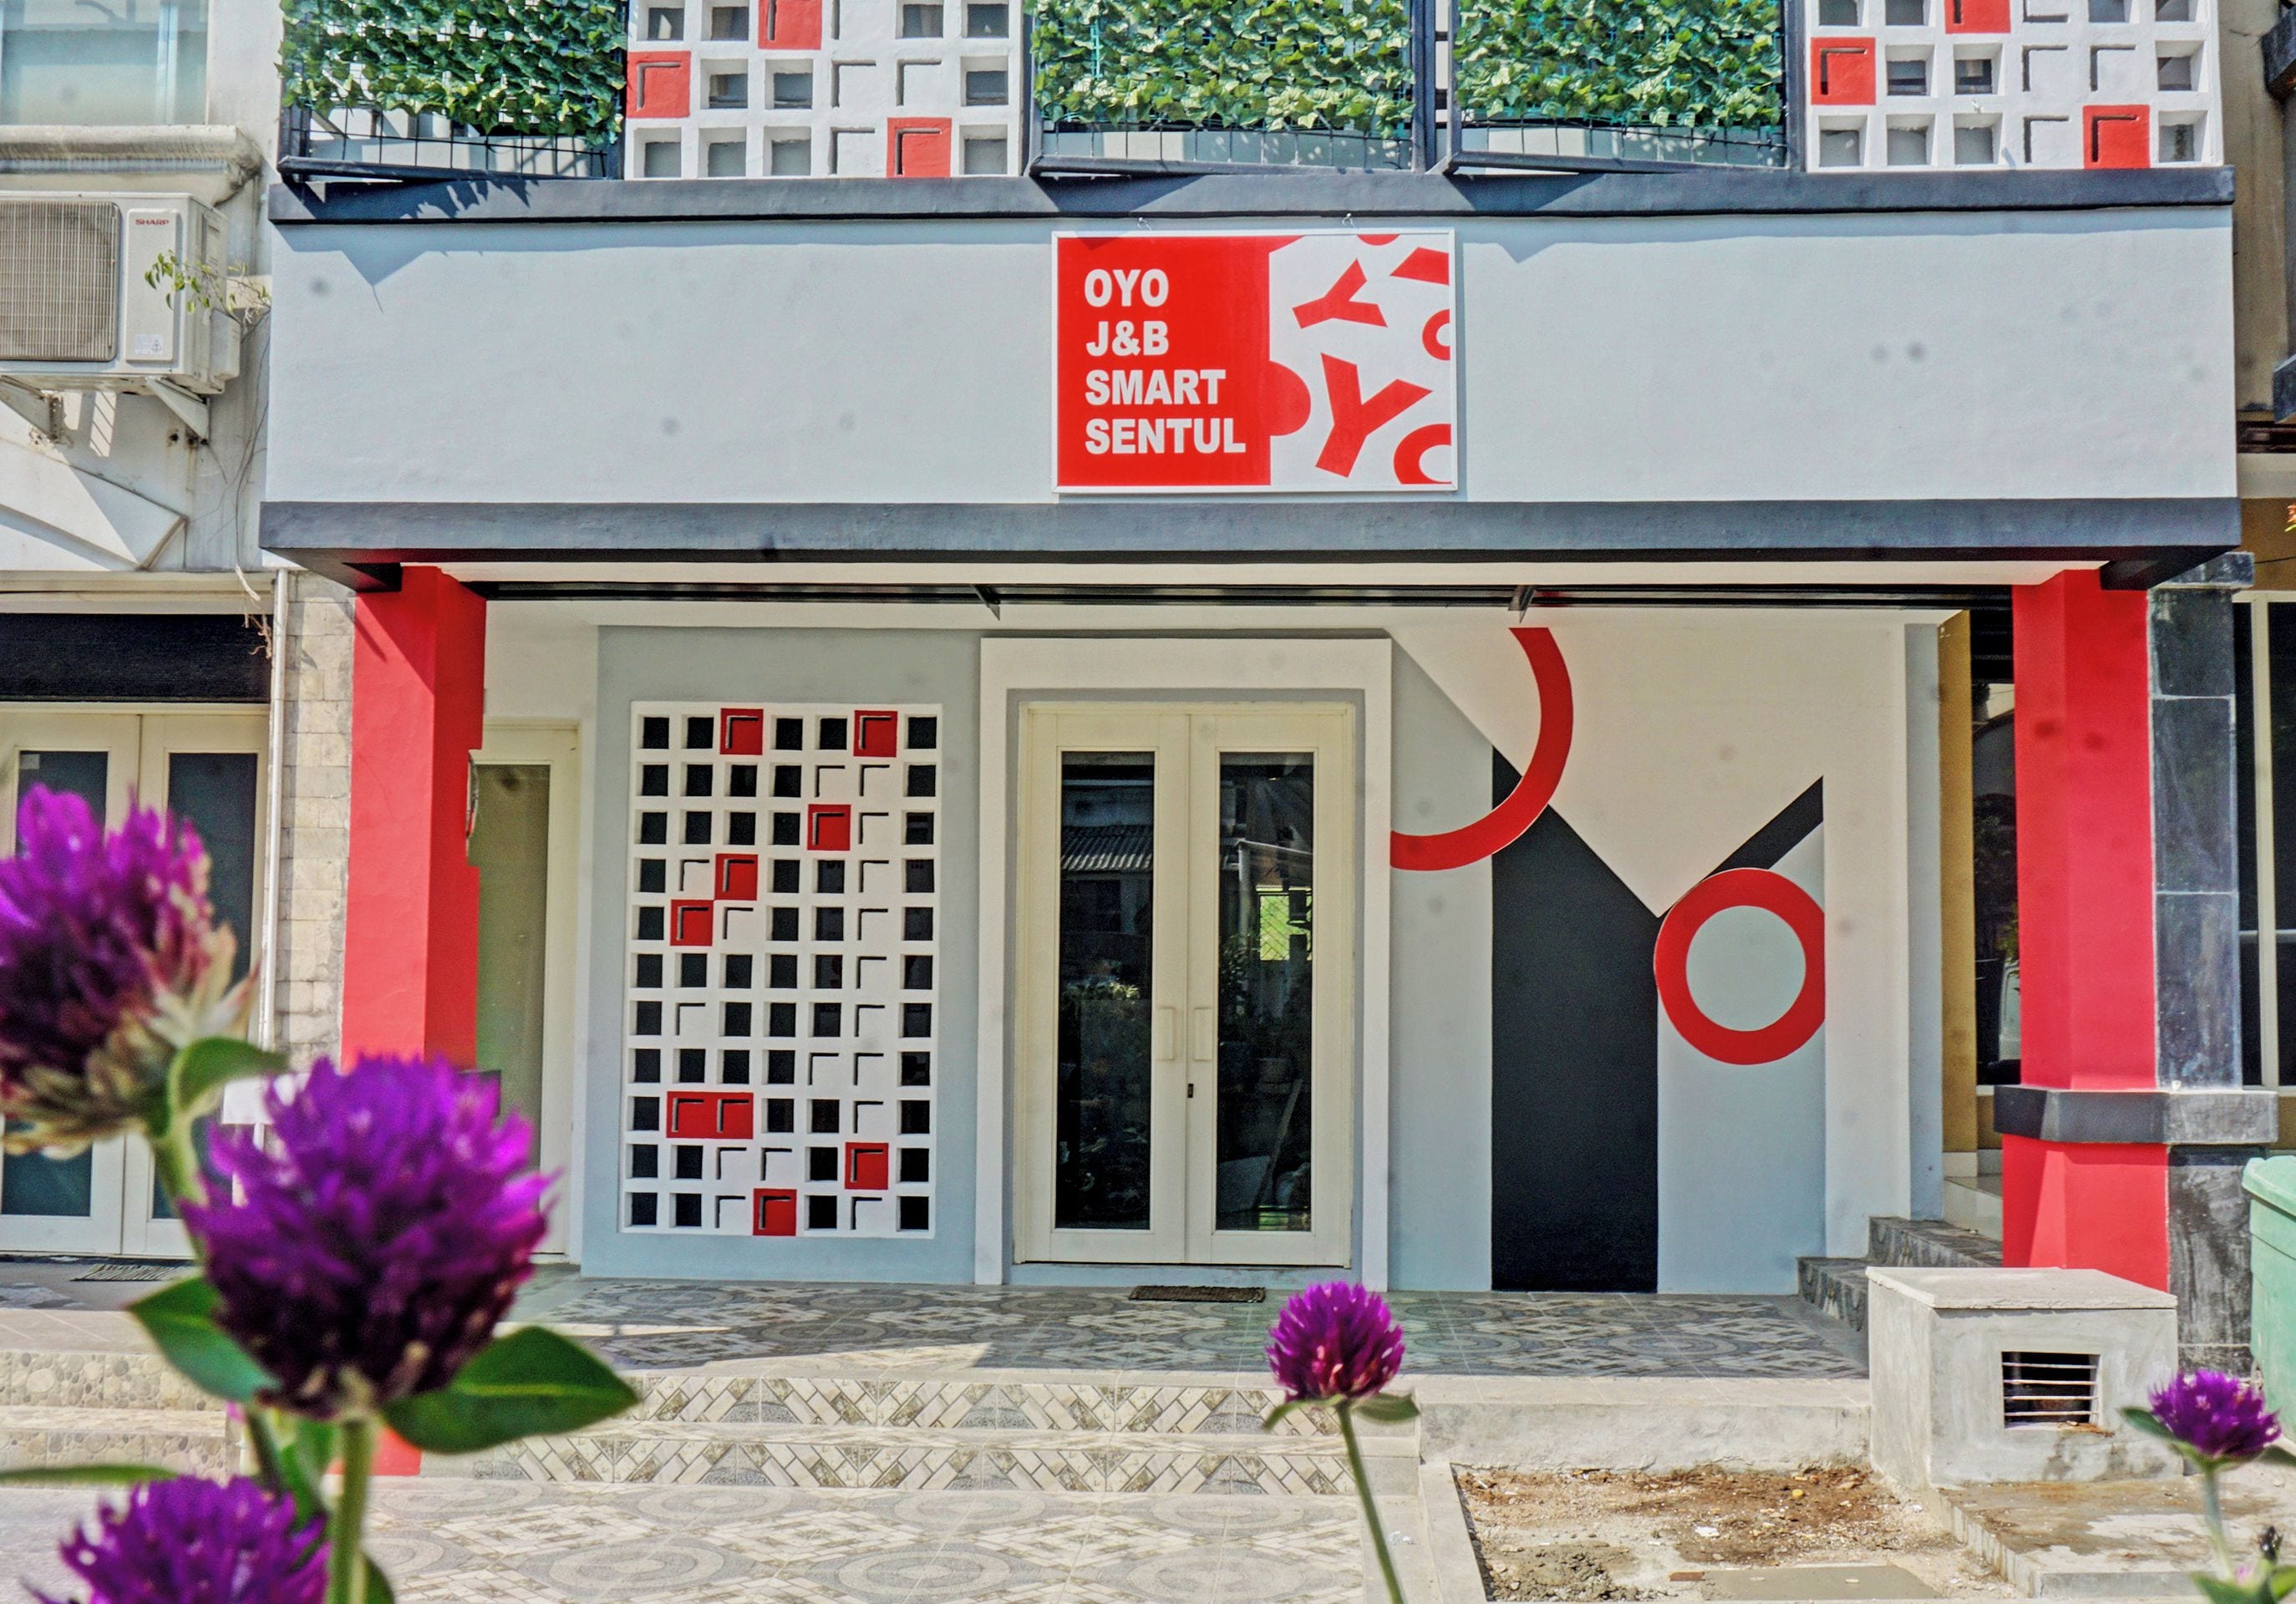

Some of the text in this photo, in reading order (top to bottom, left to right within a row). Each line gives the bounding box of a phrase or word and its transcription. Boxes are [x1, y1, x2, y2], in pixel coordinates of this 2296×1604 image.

[1085, 269, 1169, 307] OYO
[1086, 321, 1169, 356] J&B
[1085, 369, 1226, 406] SMART
[1085, 419, 1246, 455] SENTUL
